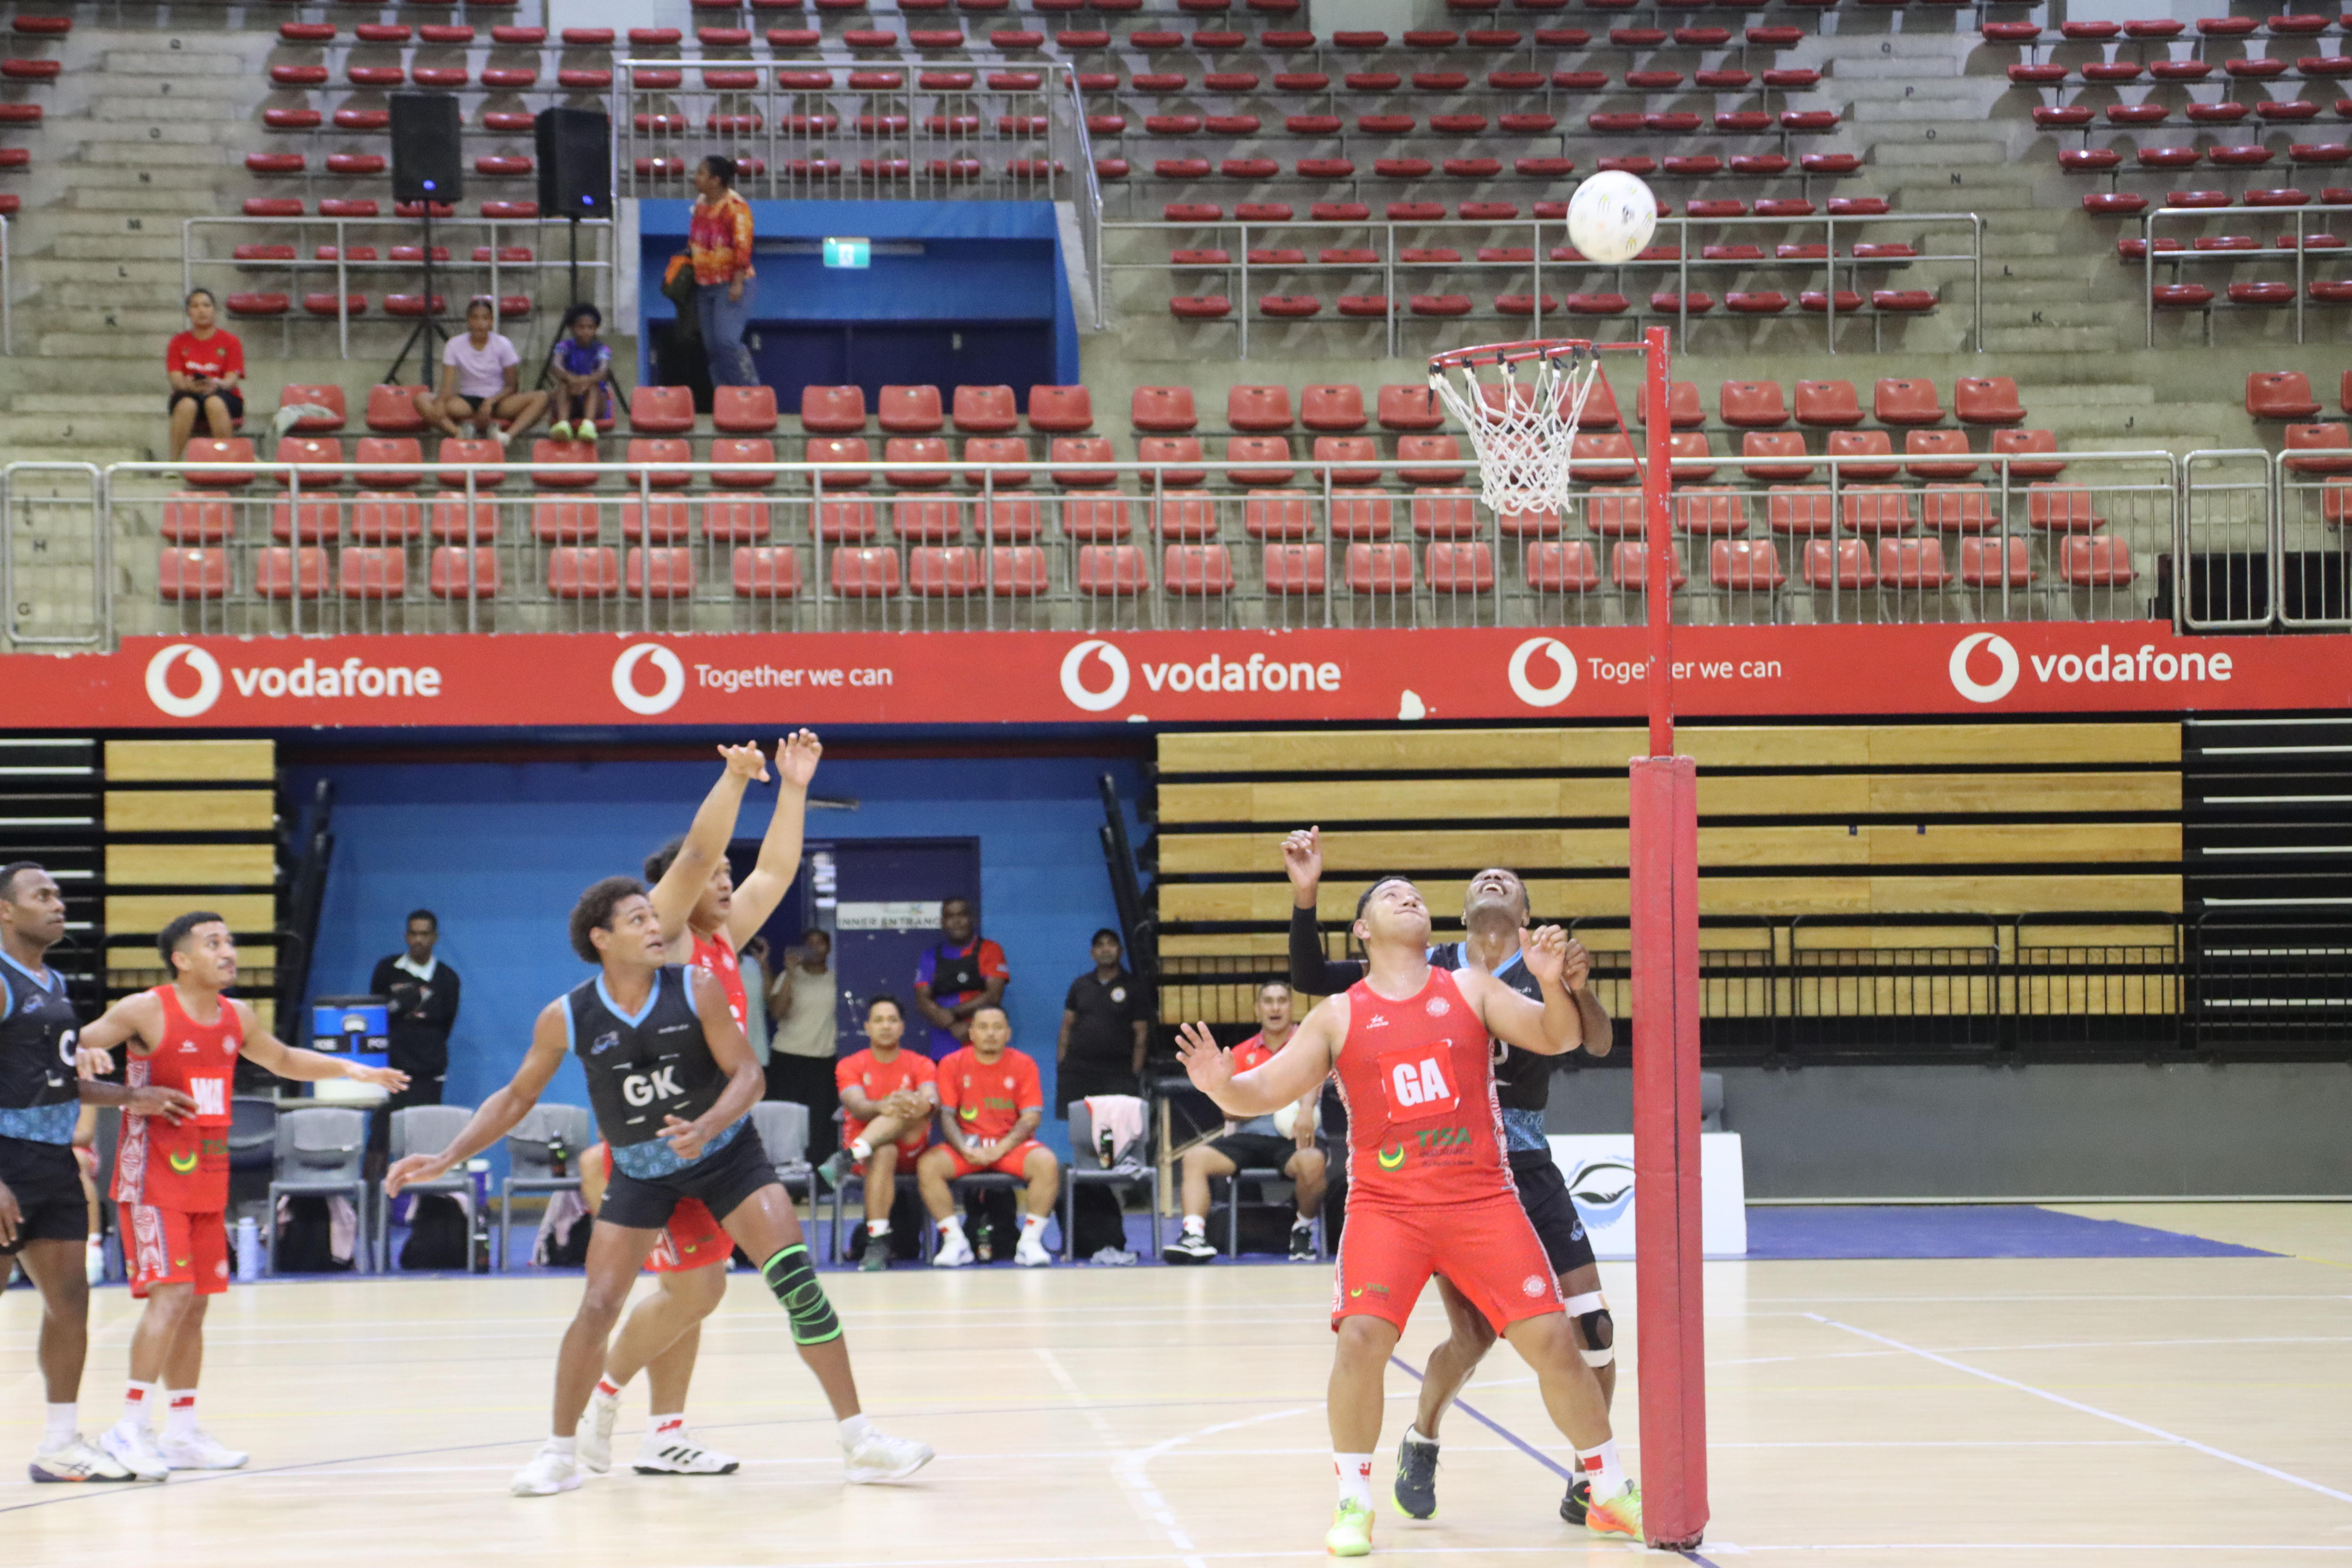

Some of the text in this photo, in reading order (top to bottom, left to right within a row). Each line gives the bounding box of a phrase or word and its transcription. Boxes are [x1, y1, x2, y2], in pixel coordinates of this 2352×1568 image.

[1906, 86, 1915, 97] P
[1951, 173, 1961, 184] N
[127, 218, 142, 230] M
[119, 265, 127, 277] L
[2004, 265, 2012, 276] L
[105, 315, 116, 326] K
[2032, 311, 2043, 323] K
[2125, 416, 2134, 429] J
[63, 424, 73, 437] J
[33, 539, 46, 551] H
[17, 602, 31, 615] G
[2030, 644, 2233, 683] vodafone
[230, 657, 442, 697] vodafone
[1141, 653, 1342, 692] vodafone
[1587, 657, 1782, 684] Togeer we can
[694, 664, 893, 693] Together we can
[623, 1065, 685, 1106] GK
[1392, 1058, 1451, 1107] GA
[1414, 1127, 1472, 1147] TISA
